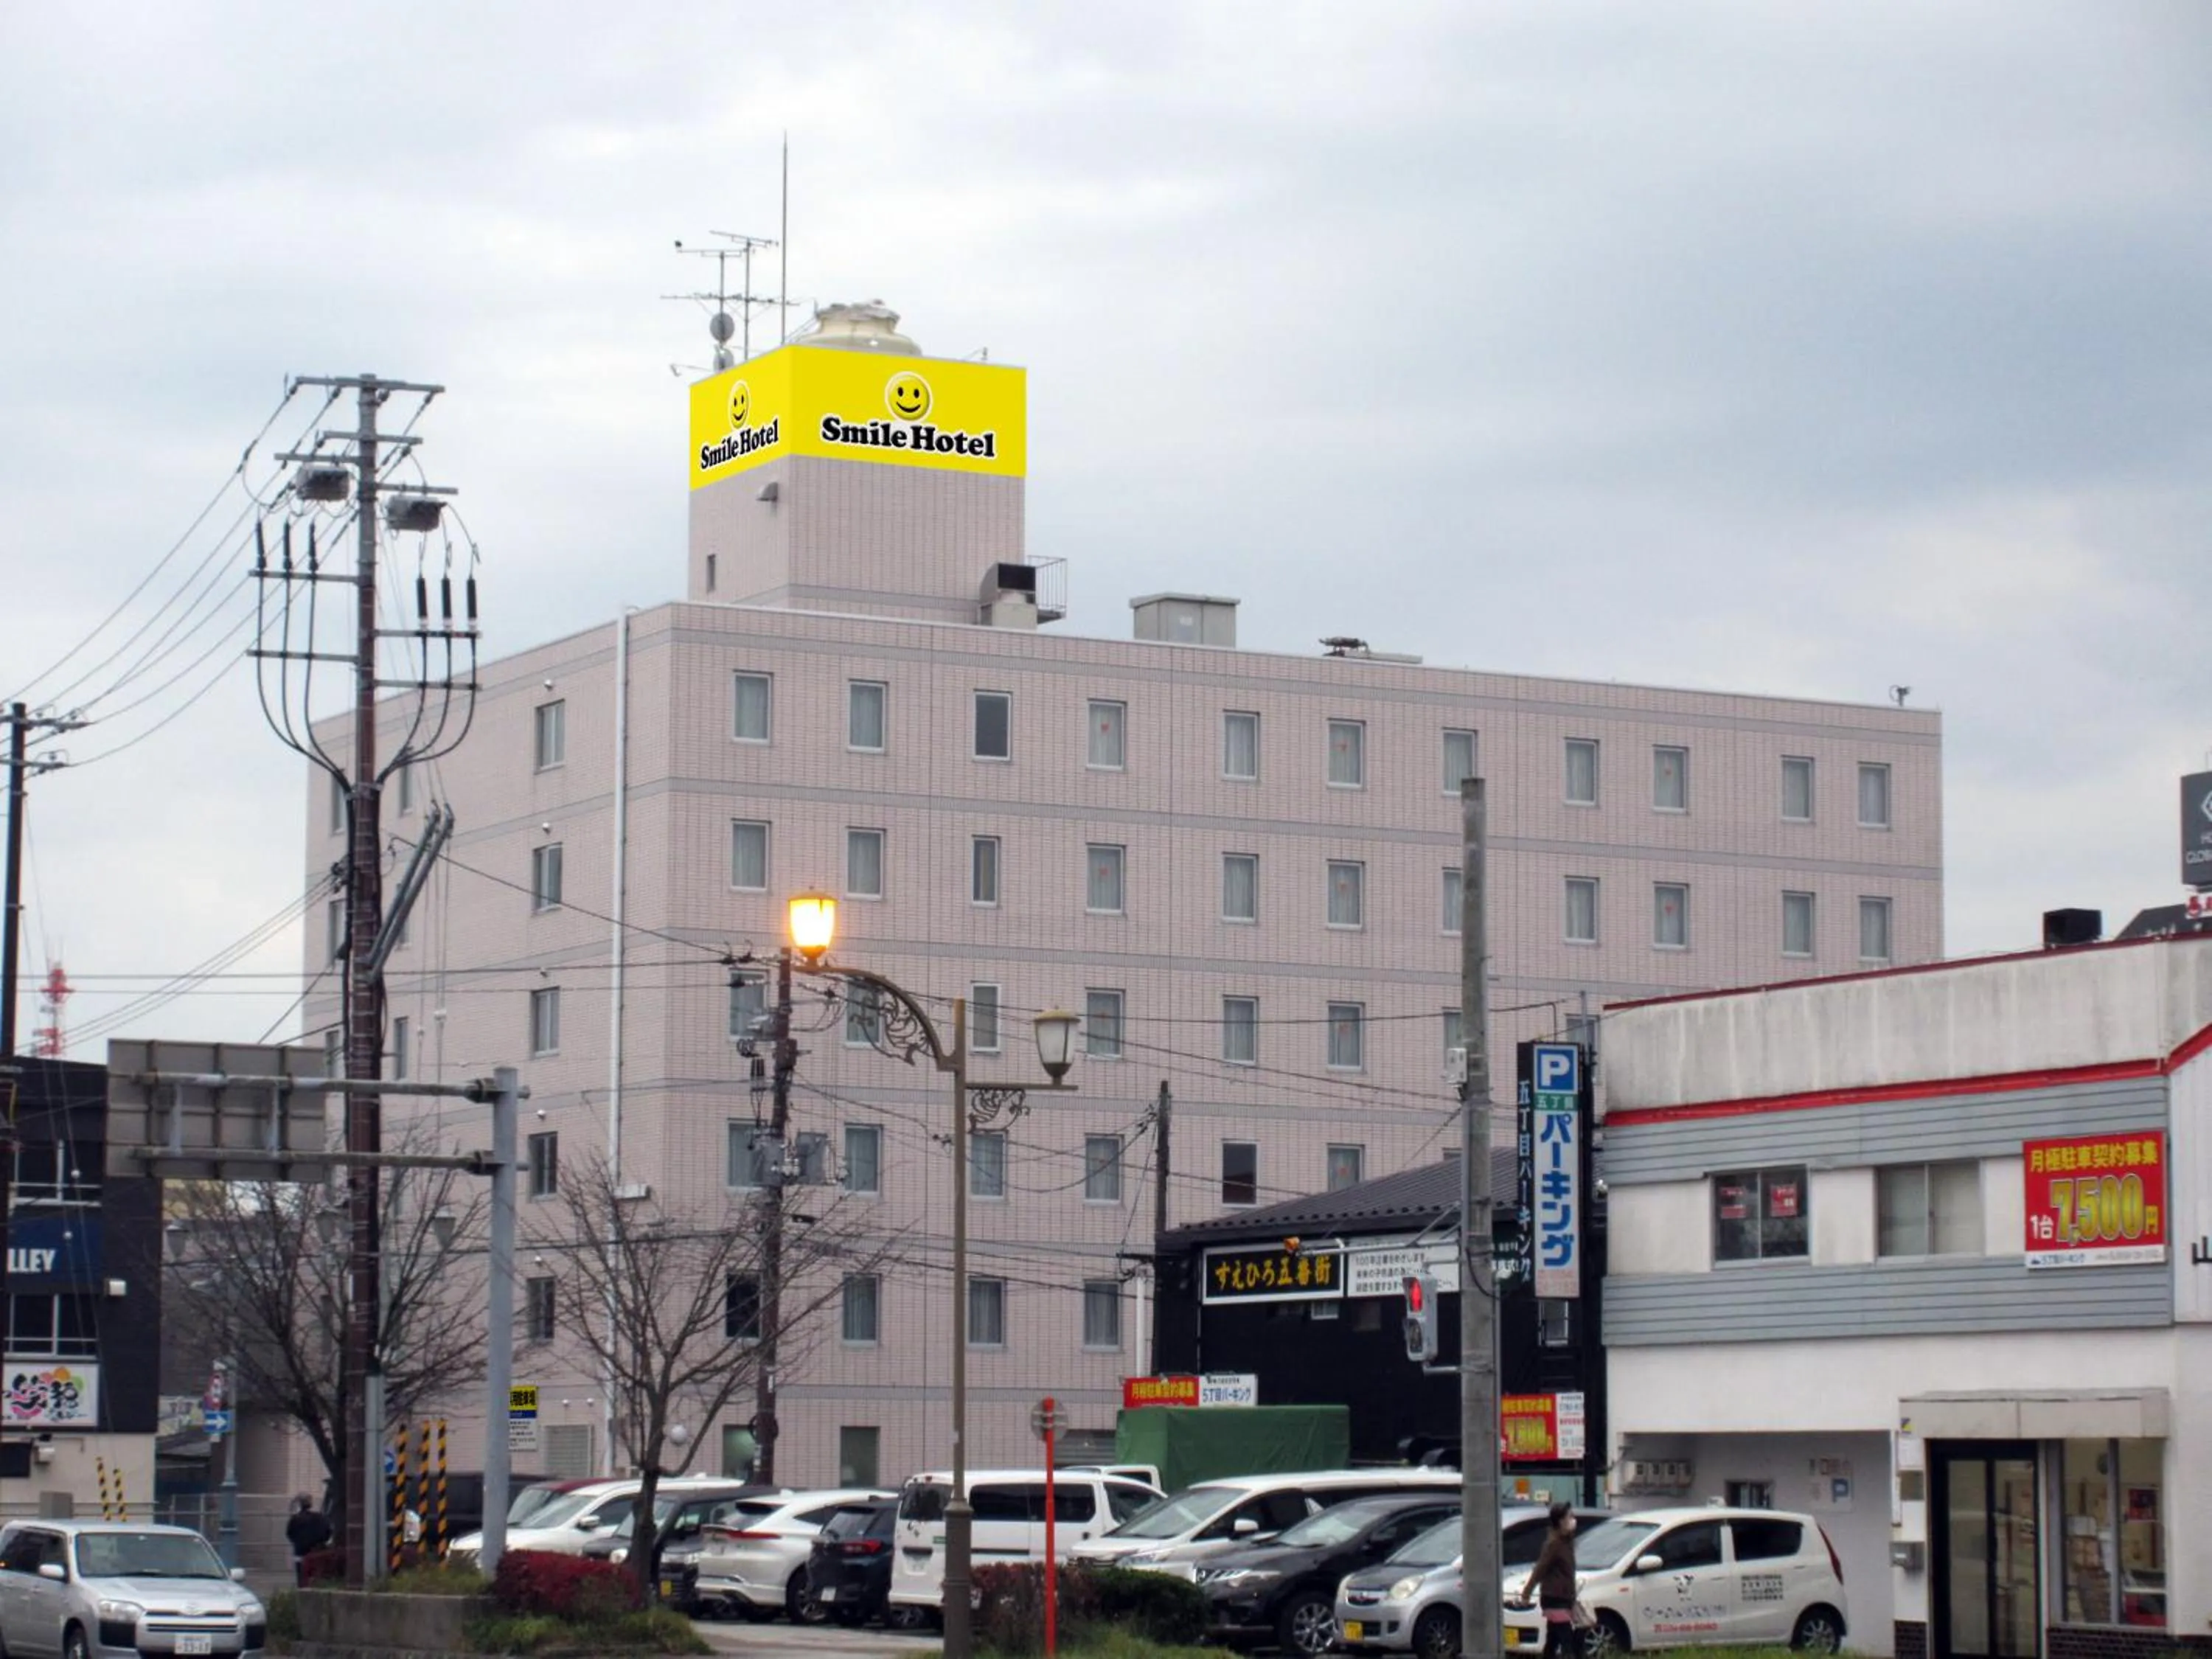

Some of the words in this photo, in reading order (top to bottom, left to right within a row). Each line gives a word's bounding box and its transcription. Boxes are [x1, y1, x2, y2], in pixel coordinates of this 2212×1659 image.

[700, 436, 738, 469] Smile
[738, 419, 779, 455] Hotel
[821, 417, 908, 448] Smile
[911, 425, 995, 457] Hotel
[1541, 1054, 1570, 1086] P
[1540, 1113, 1574, 1267] パーキング
